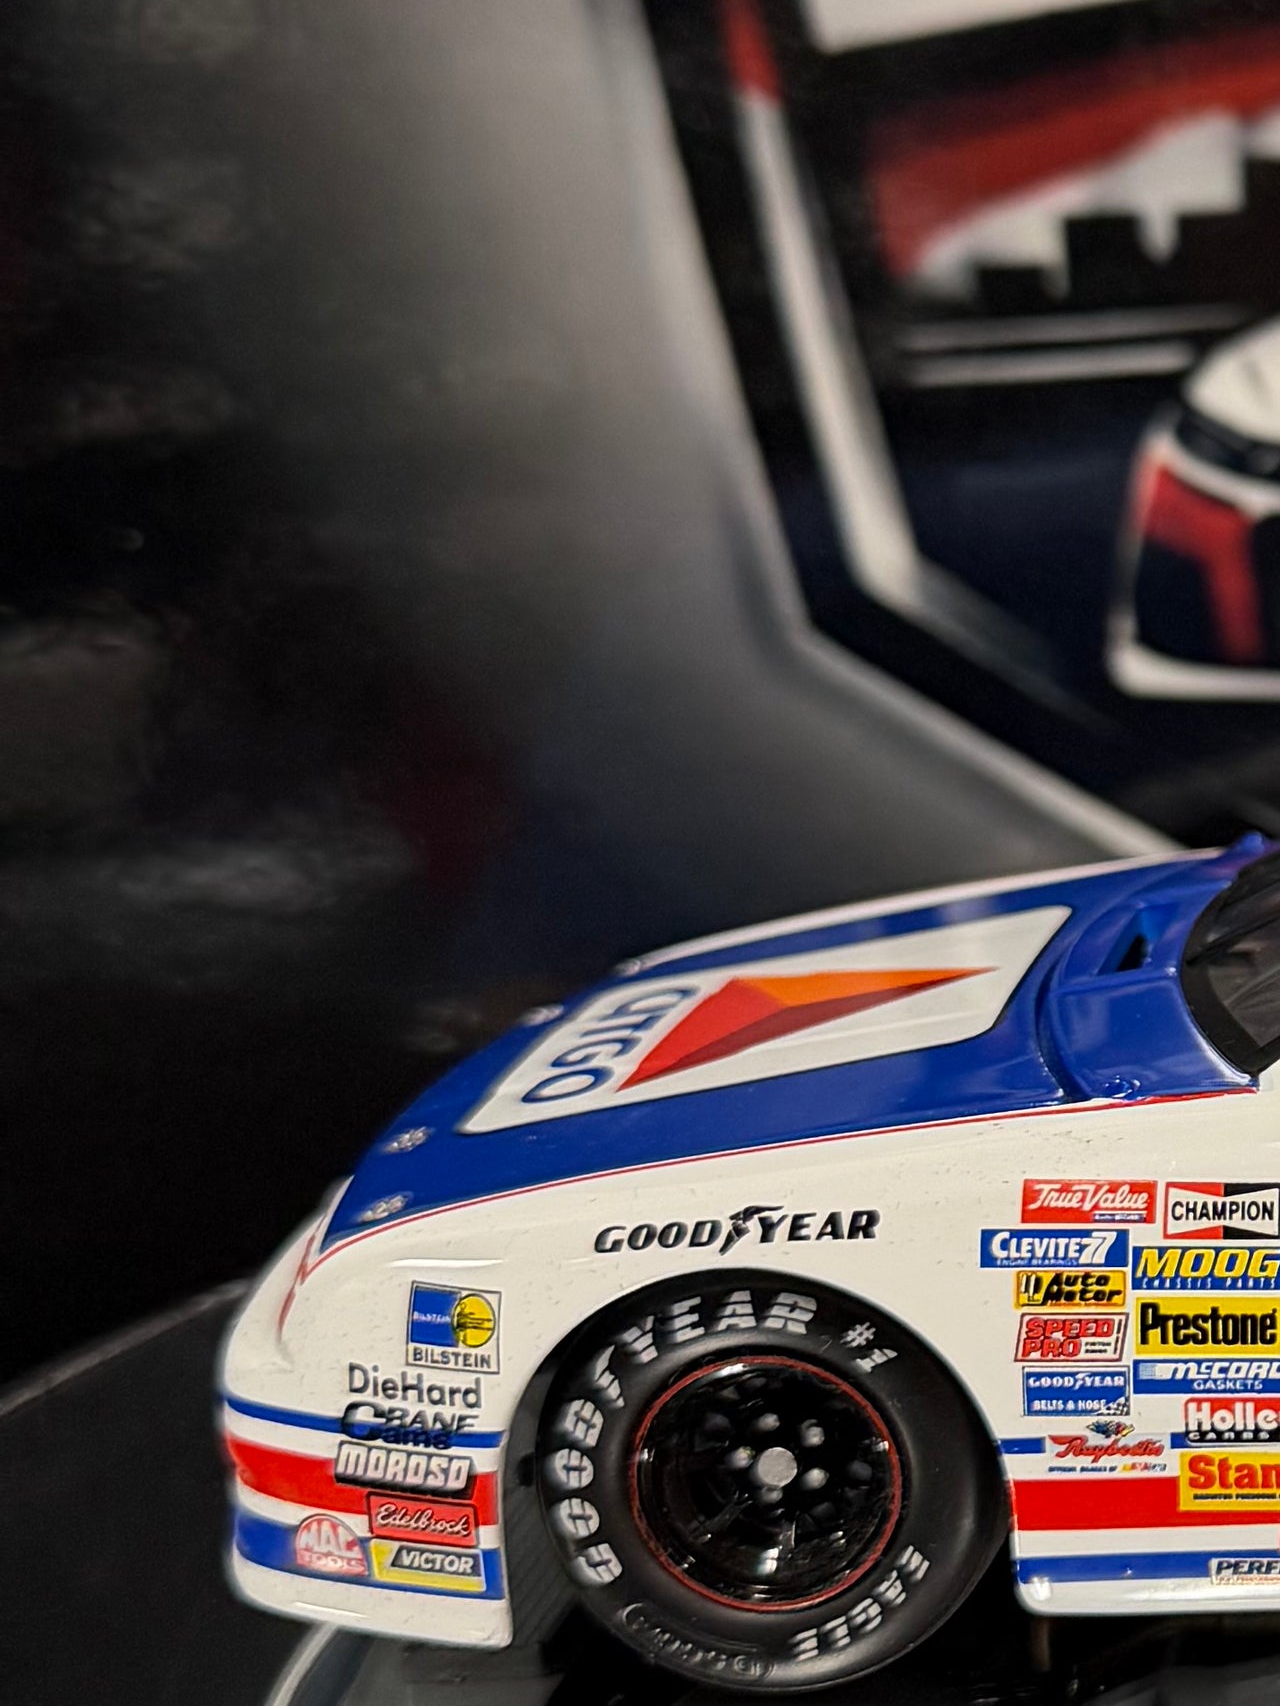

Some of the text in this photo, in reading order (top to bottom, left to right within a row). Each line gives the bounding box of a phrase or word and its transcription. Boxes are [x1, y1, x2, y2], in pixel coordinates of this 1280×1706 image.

[521, 983, 700, 1104] CITGO
[1171, 1200, 1274, 1221] CHAMPION
[594, 1204, 881, 1255] GOODYEAR
[1142, 1277, 1276, 1289] CHASSIS PARTS
[1025, 1317, 1115, 1337] SPEED
[1140, 1302, 1277, 1345] Prestone
[413, 1346, 491, 1369] BILSTEIN
[1022, 1337, 1082, 1357] PRO
[349, 1362, 482, 1408] DieHard
[1193, 1380, 1263, 1390] GASKETS
[1032, 1399, 1064, 1410] BELTS
[341, 1400, 479, 1441] CRANE
[336, 1443, 472, 1490] MOROSO
[376, 1503, 470, 1537] Edelbrock
[299, 1520, 361, 1560] MAC
[301, 1550, 365, 1574] TOOLS
[400, 1549, 473, 1574] VICTOR
